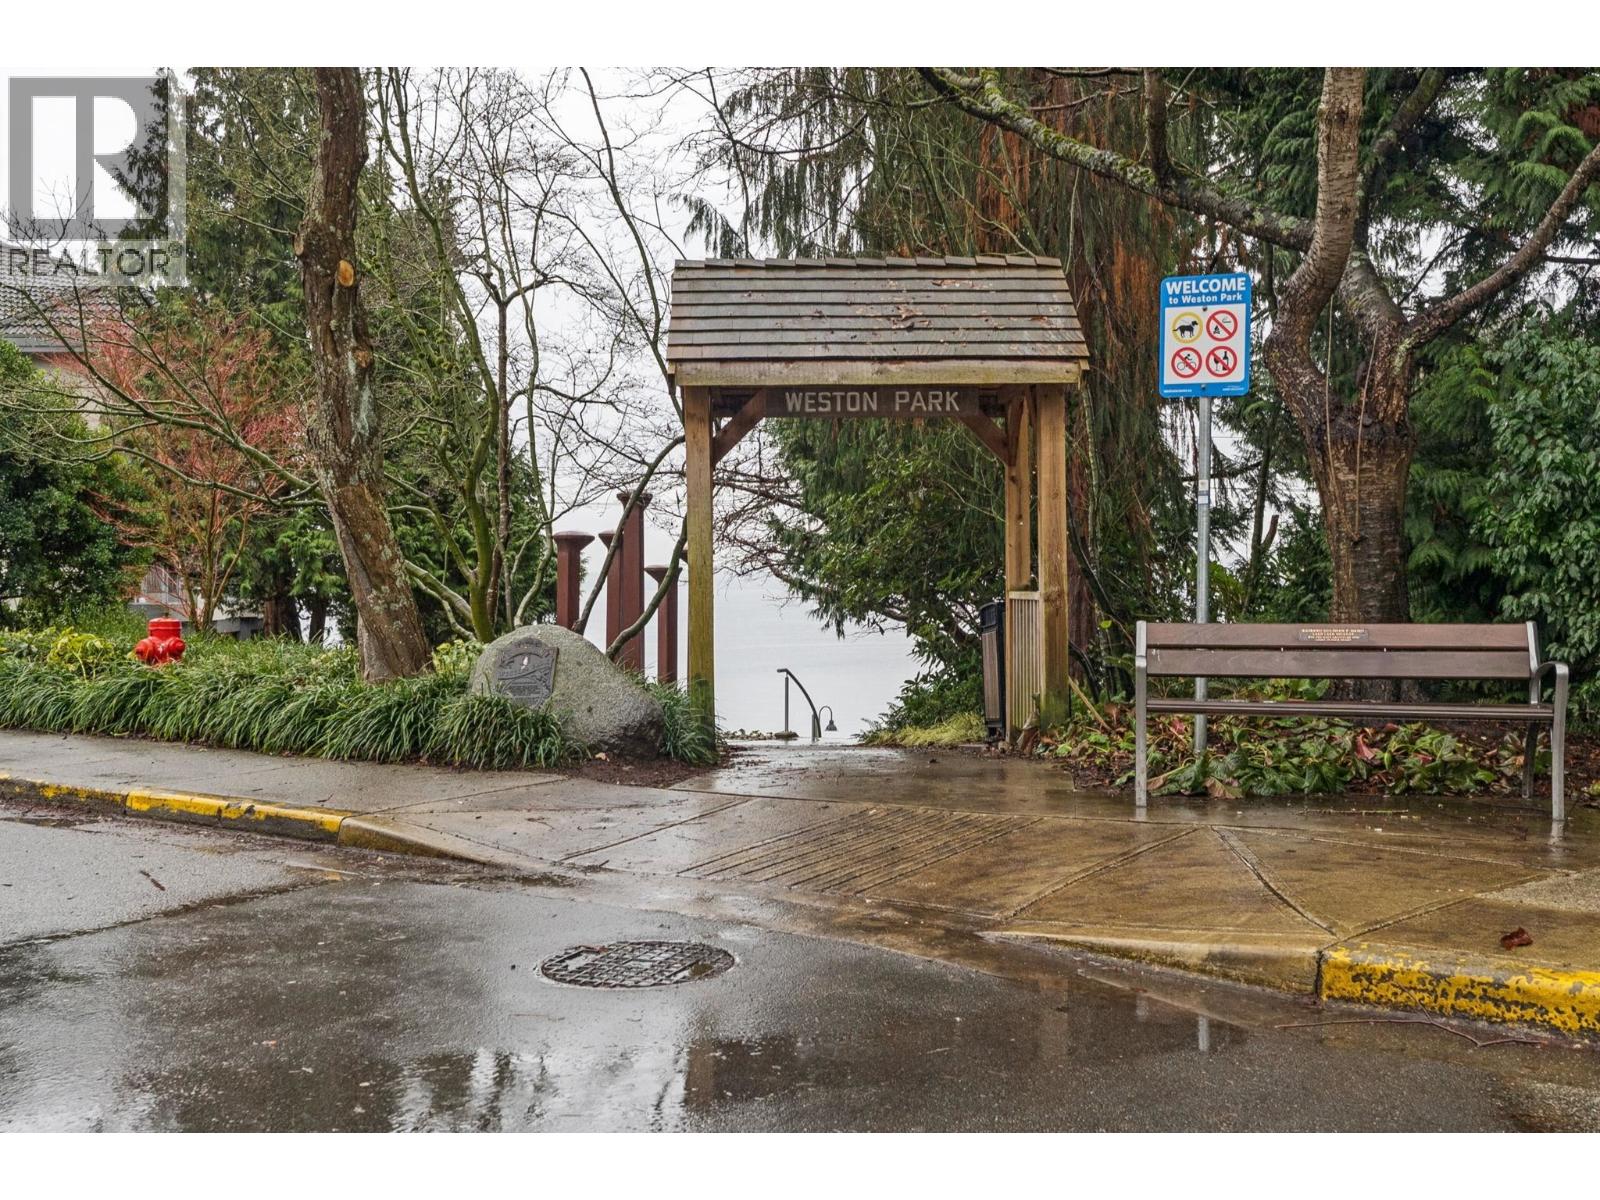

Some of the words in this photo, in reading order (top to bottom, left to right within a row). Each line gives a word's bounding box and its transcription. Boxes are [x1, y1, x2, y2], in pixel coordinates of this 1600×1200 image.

[1166, 277, 1246, 294] WELCOME
[1181, 295, 1217, 304] Weston
[1220, 292, 1242, 302] Park
[785, 391, 878, 412] WESTON
[894, 391, 960, 412] PARK
